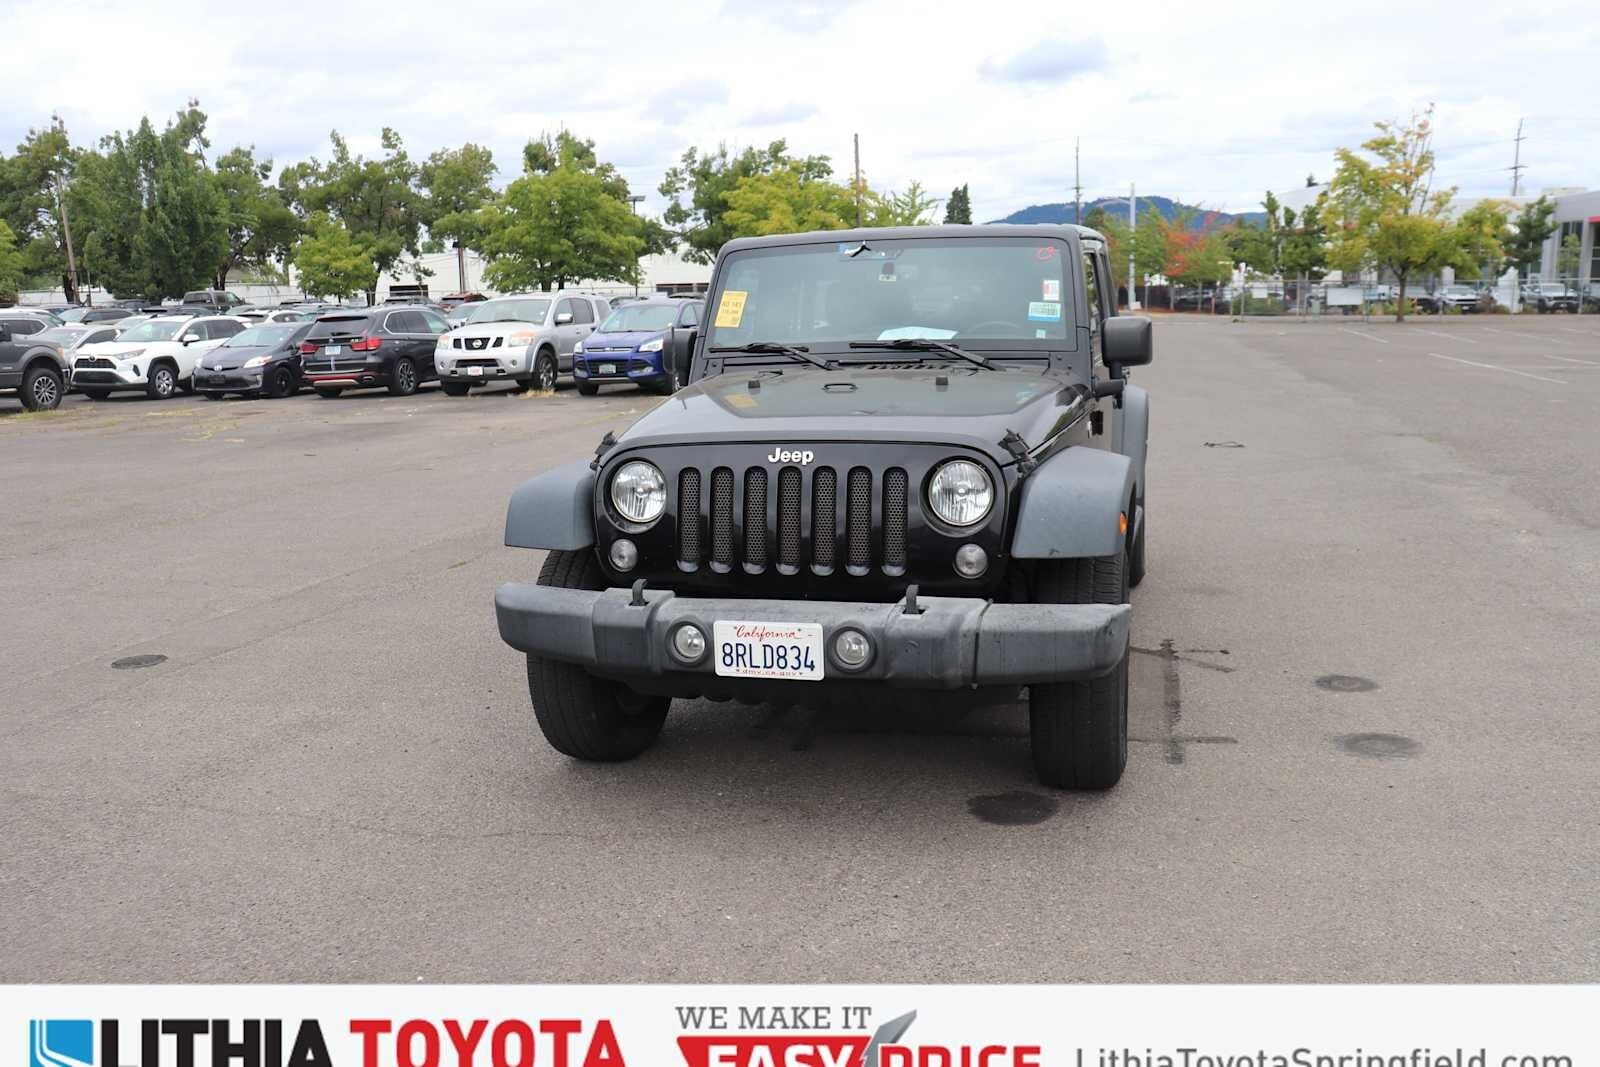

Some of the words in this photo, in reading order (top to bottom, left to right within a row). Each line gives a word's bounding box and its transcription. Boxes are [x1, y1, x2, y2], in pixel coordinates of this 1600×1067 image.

[767, 447, 815, 466] Jeep
[735, 625, 800, 641] California
[722, 642, 815, 671] 8RLD834
